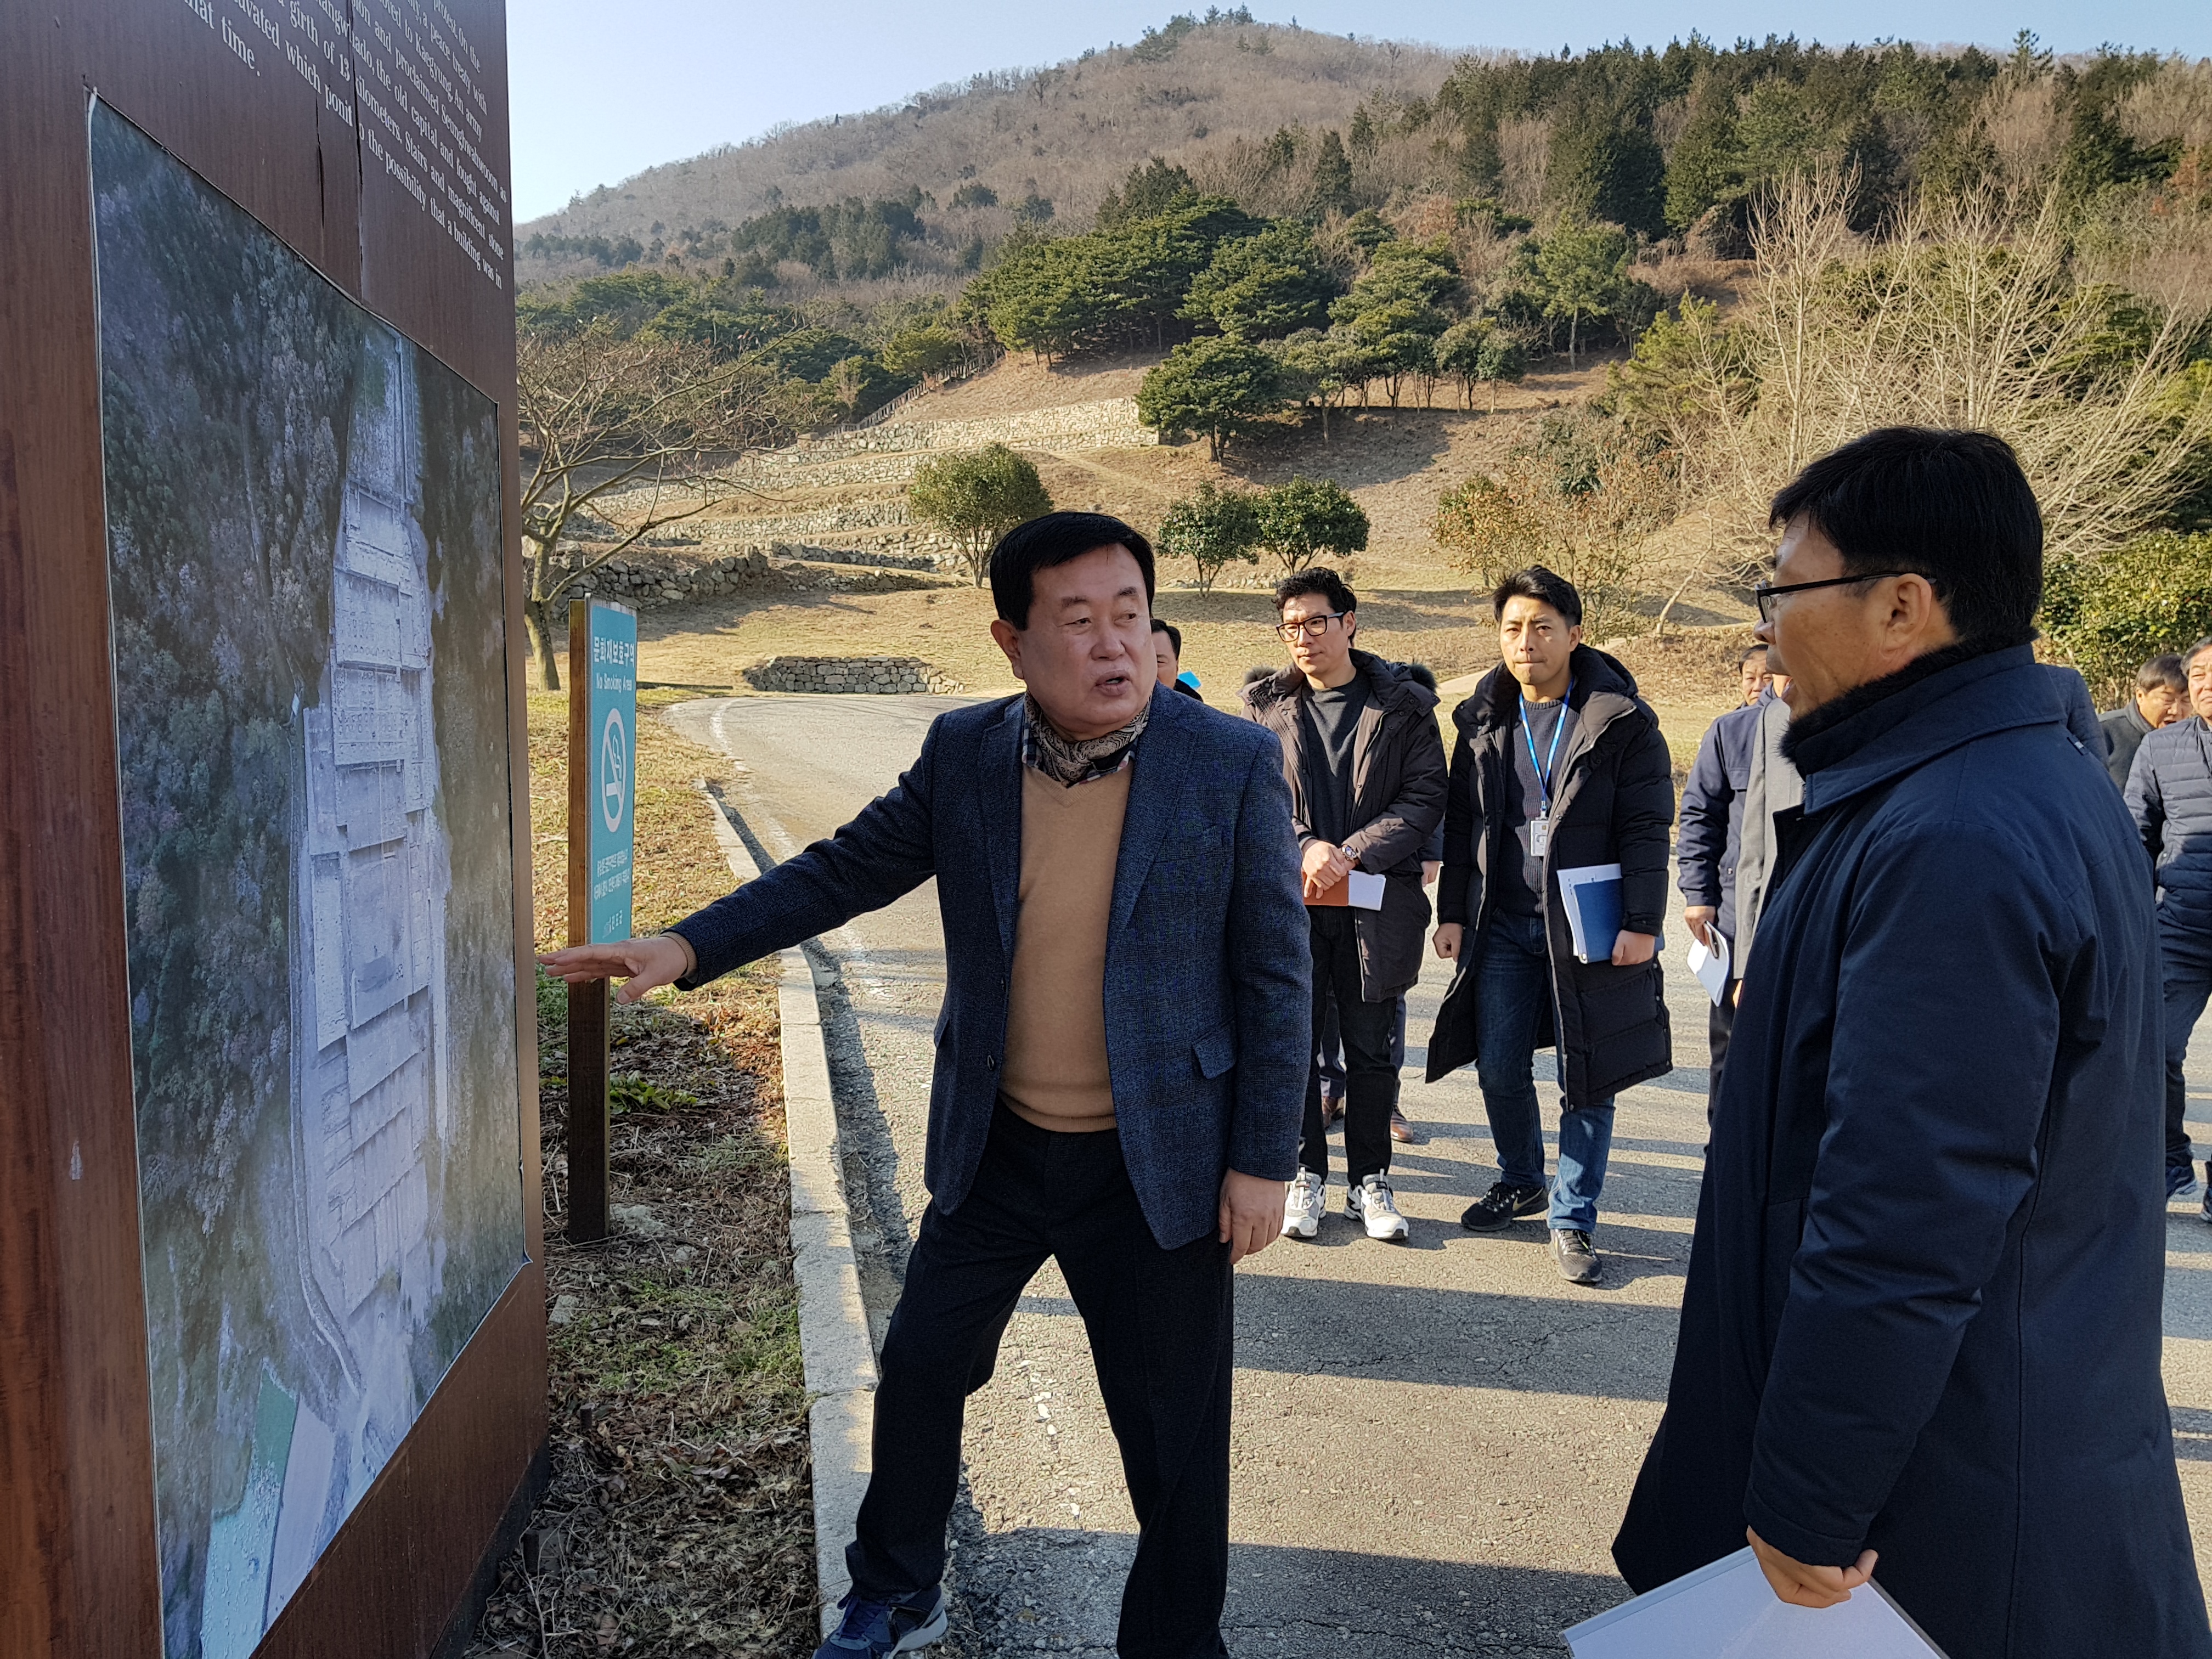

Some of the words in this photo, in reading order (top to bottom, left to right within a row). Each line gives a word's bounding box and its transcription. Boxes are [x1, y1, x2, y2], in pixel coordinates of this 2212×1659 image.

[375, 20, 392, 55] and
[395, 47, 439, 116] proclaimed
[500, 186, 507, 203] as
[404, 19, 413, 43] to
[454, 89, 464, 115] An
[466, 108, 482, 143] army
[430, 22, 450, 61] peace
[452, 52, 471, 95] treaty
[472, 84, 487, 116] with
[470, 45, 481, 74] the
[285, 40, 323, 94] which
[324, 83, 353, 127] ponit
[359, 123, 365, 140] o
[368, 128, 383, 161] the
[385, 151, 426, 211] possibility
[430, 198, 445, 228] that
[448, 220, 453, 236] a
[454, 221, 481, 271] building
[483, 258, 494, 281] was
[495, 269, 503, 290] in
[290, 1, 319, 47] girth
[324, 40, 335, 65] of
[339, 54, 350, 81] 13
[405, 131, 427, 172] Stairs
[431, 166, 445, 193] and
[448, 185, 486, 240] magnificent
[488, 233, 504, 260] stone
[376, 58, 391, 92] the
[394, 84, 408, 113] old
[411, 106, 438, 149] capital
[440, 142, 454, 169] and
[456, 157, 477, 198] fought
[479, 191, 500, 225] against
[594, 636, 635, 668] 문화재보호구역
[604, 673, 622, 693] Smoking
